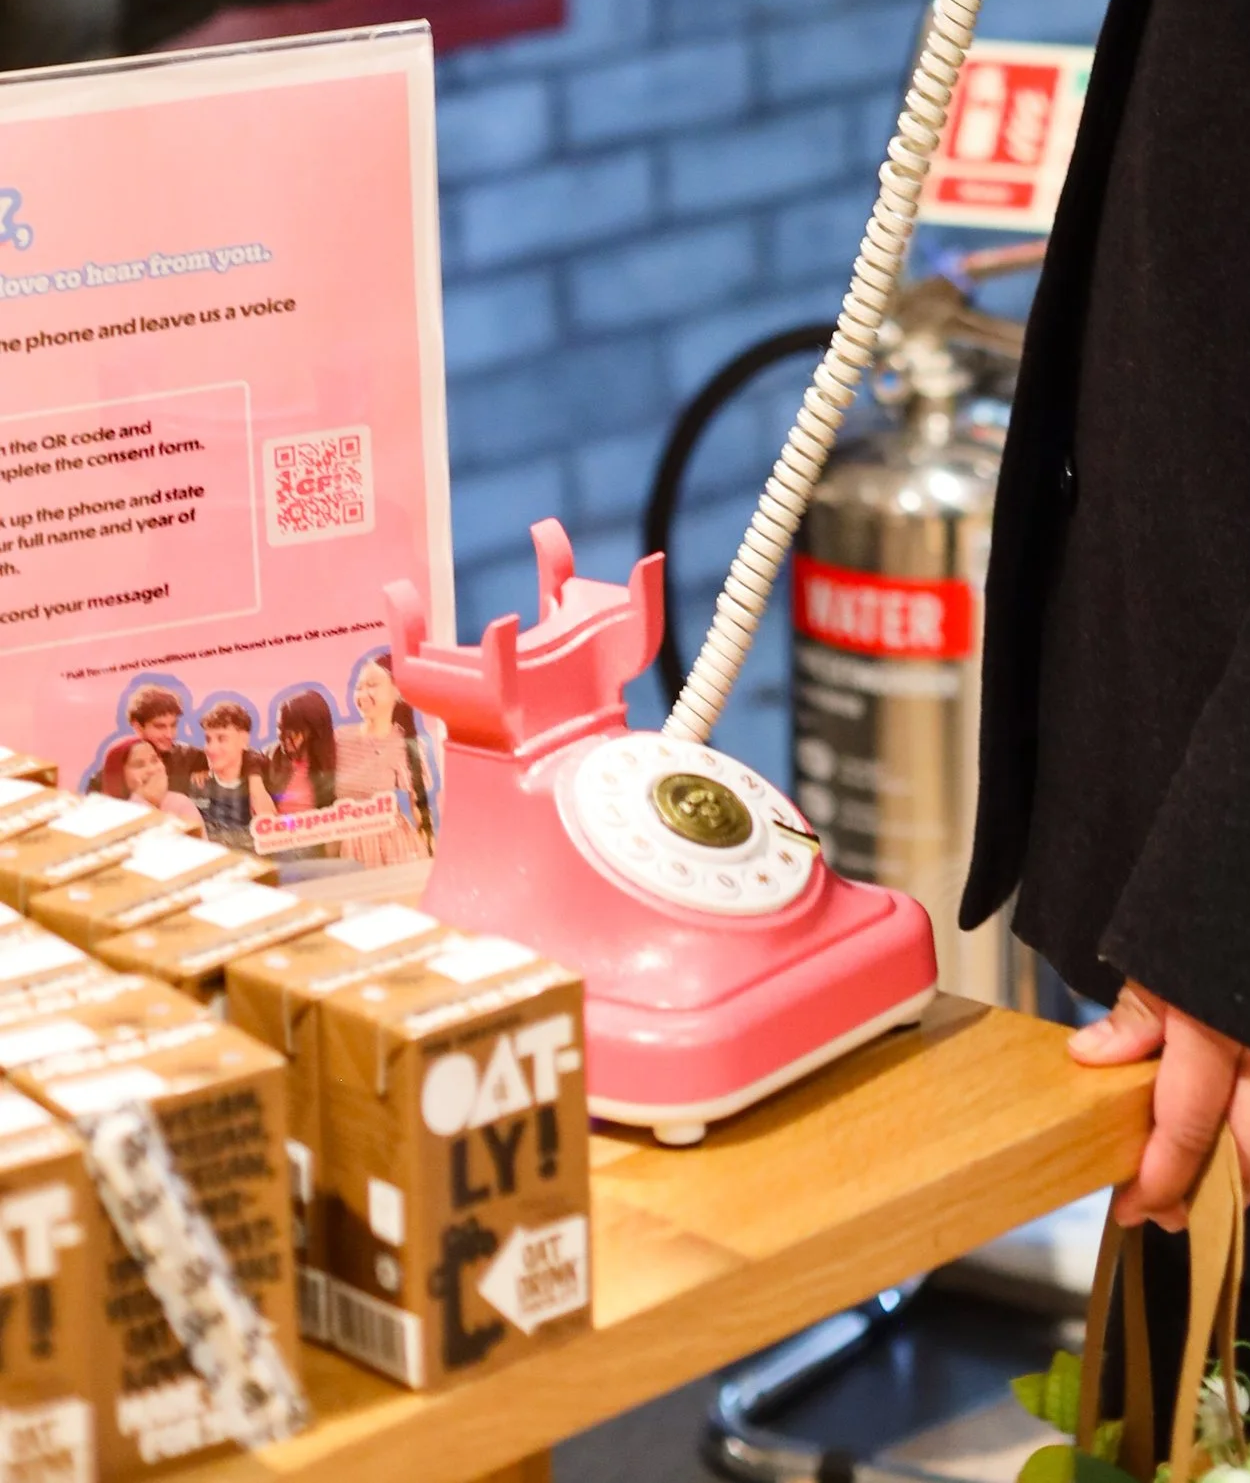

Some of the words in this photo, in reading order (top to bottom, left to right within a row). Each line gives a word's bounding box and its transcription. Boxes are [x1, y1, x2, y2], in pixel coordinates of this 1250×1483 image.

[55, 270, 82, 293] to
[86, 261, 145, 287] hear
[148, 251, 212, 279] from
[214, 242, 272, 274] you.
[25, 326, 94, 354] phone
[98, 318, 137, 341] and
[140, 311, 197, 334] leave
[199, 307, 221, 324] us
[225, 304, 237, 321] a
[240, 297, 297, 319] voice
[9, 440, 38, 456] the
[41, 434, 67, 451] QR
[71, 427, 116, 446] code
[119, 420, 152, 439] and
[55, 456, 84, 472] the
[87, 445, 155, 468] consent
[158, 438, 206, 457] form.
[10, 514, 33, 529] up
[36, 507, 65, 523] the
[68, 499, 126, 521] phone
[129, 490, 162, 509] and
[164, 485, 205, 503] state
[18, 532, 44, 550] full
[47, 527, 97, 545] name
[99, 518, 133, 537] and
[136, 514, 176, 535] year
[178, 507, 197, 524] of
[43, 599, 85, 620] your
[87, 583, 170, 610] message!
[806, 577, 945, 650] WATER
[421, 1013, 583, 1136] OAT-
[451, 1103, 558, 1208] LY!
